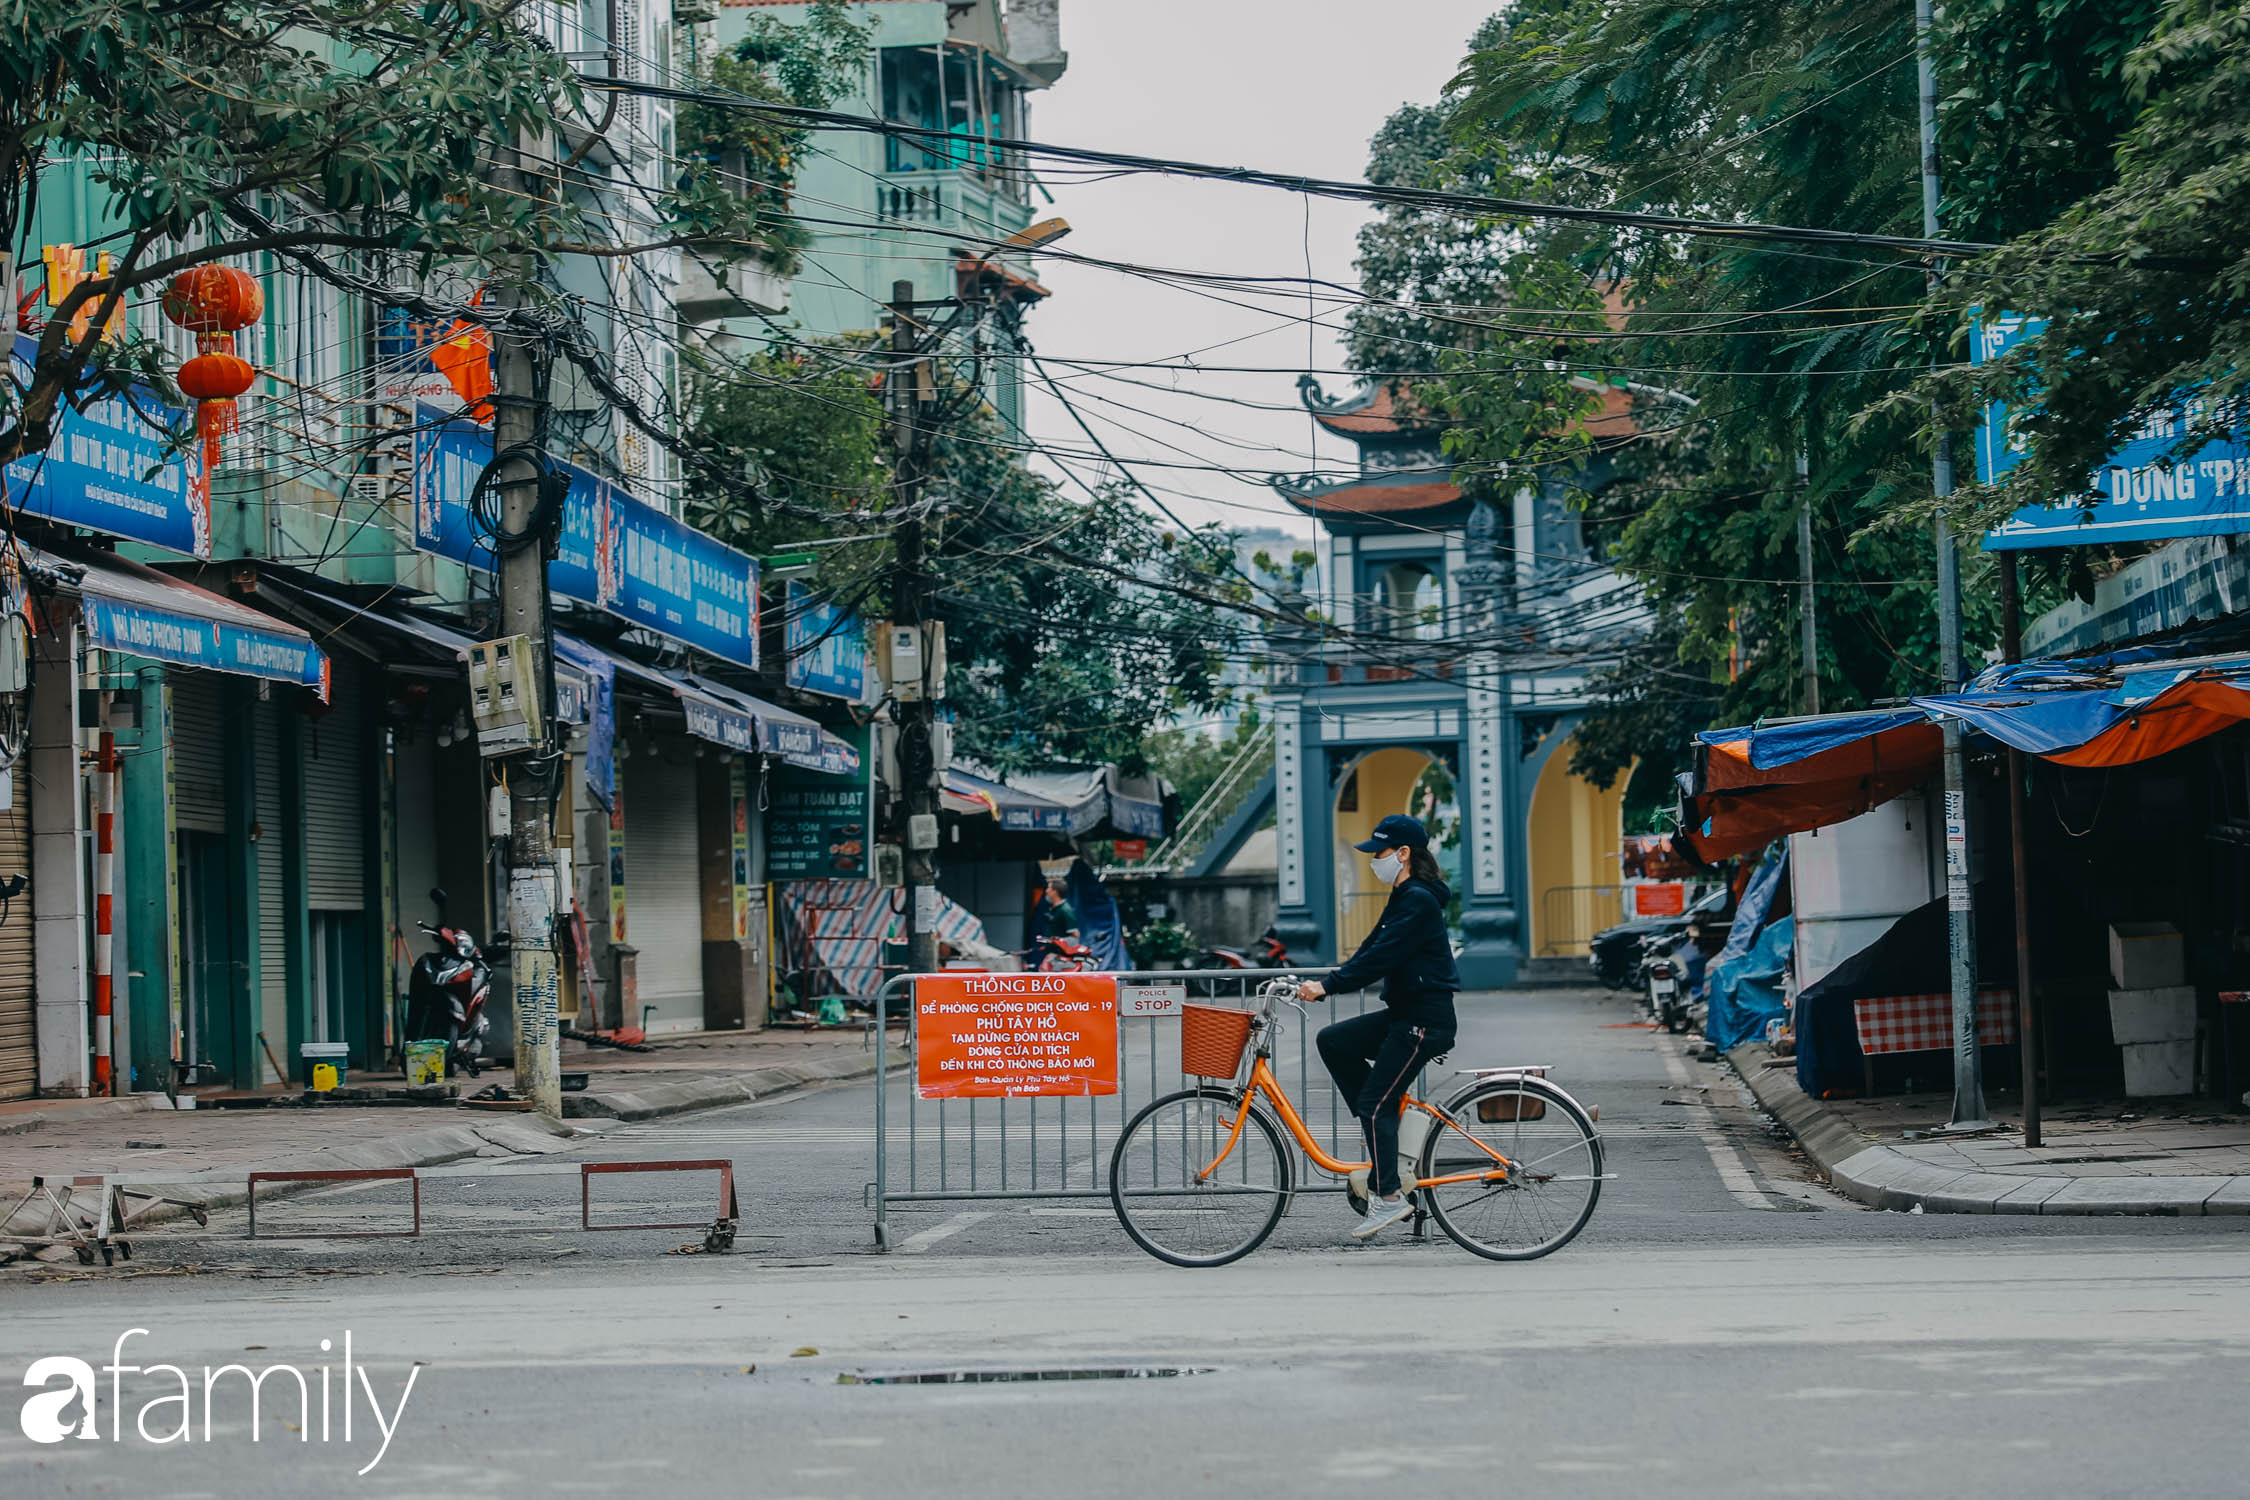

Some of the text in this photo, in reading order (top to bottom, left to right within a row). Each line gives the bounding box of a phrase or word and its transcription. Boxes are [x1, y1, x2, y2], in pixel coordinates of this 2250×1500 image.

[964, 976, 1066, 993] THÔNG BÁO
[1138, 989, 1168, 997] POLICE
[921, 1000, 937, 1014] ĐỂ
[940, 1002, 979, 1013] PHÒNG
[981, 1000, 1024, 1013] CHỐNG
[1026, 1002, 1053, 1014] DỊCH
[1101, 1002, 1112, 1011] 19
[1135, 1000, 1172, 1011] STOP
[976, 1012, 1057, 1029] PHỦ TÂY HỒ
[952, 1029, 1080, 1045] TẠM DỪNG ĐÓN KHÁCH
[968, 1043, 1070, 1057] ĐÓNG CỬA DI TÍCH
[940, 1056, 1095, 1071] ĐẾN KHI CÓ THÔNG BÁO MỚI
[1015, 1075, 1024, 1085] Lý
[1023, 1084, 1040, 1093] Báo
